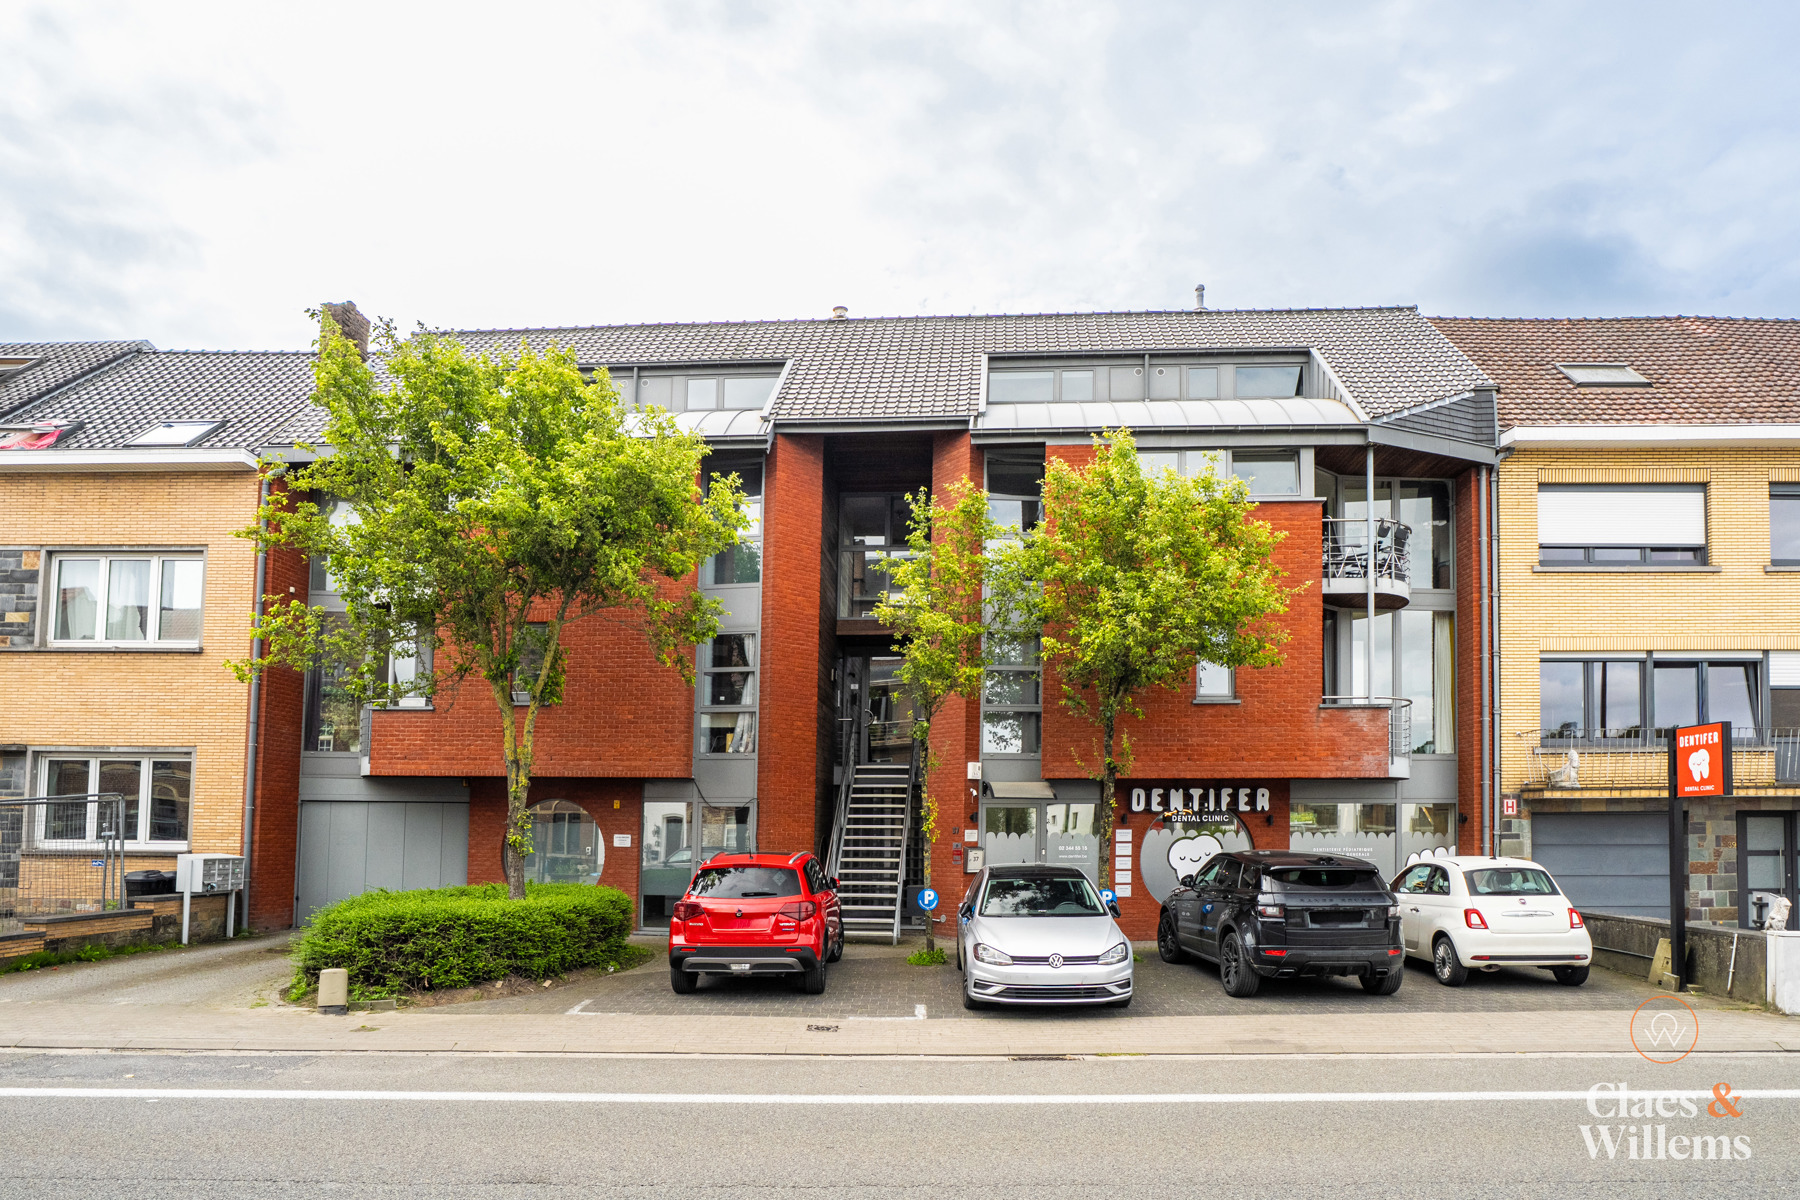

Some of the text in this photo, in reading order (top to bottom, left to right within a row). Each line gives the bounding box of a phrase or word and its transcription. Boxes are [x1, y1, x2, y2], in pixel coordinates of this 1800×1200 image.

[1679, 731, 1719, 748] DENTIFER
[1131, 787, 1270, 812] DENTIFER
[1505, 800, 1515, 813] H
[1171, 814, 1229, 822] DENTAL CLINIC
[924, 890, 935, 905] P
